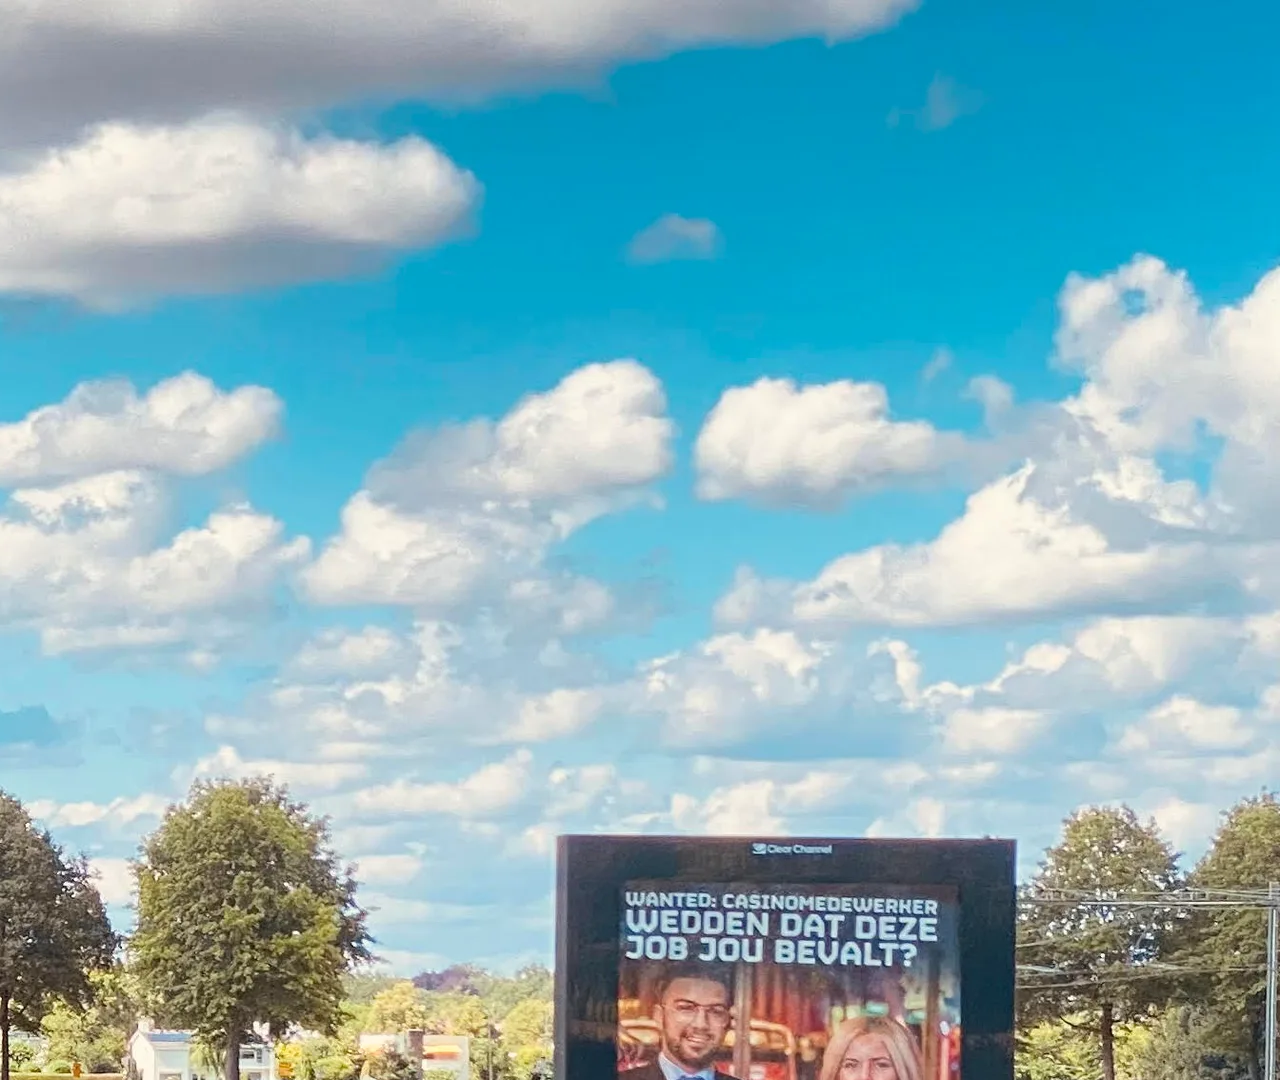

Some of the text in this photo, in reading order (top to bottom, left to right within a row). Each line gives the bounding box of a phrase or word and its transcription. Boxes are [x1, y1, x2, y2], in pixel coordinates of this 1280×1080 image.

[625, 891, 938, 915] WANTED: CASINOMEDEWERKER
[626, 910, 938, 942] WEDDEN DAT DEZE
[625, 935, 917, 967] JOB JOU BEVALT?
